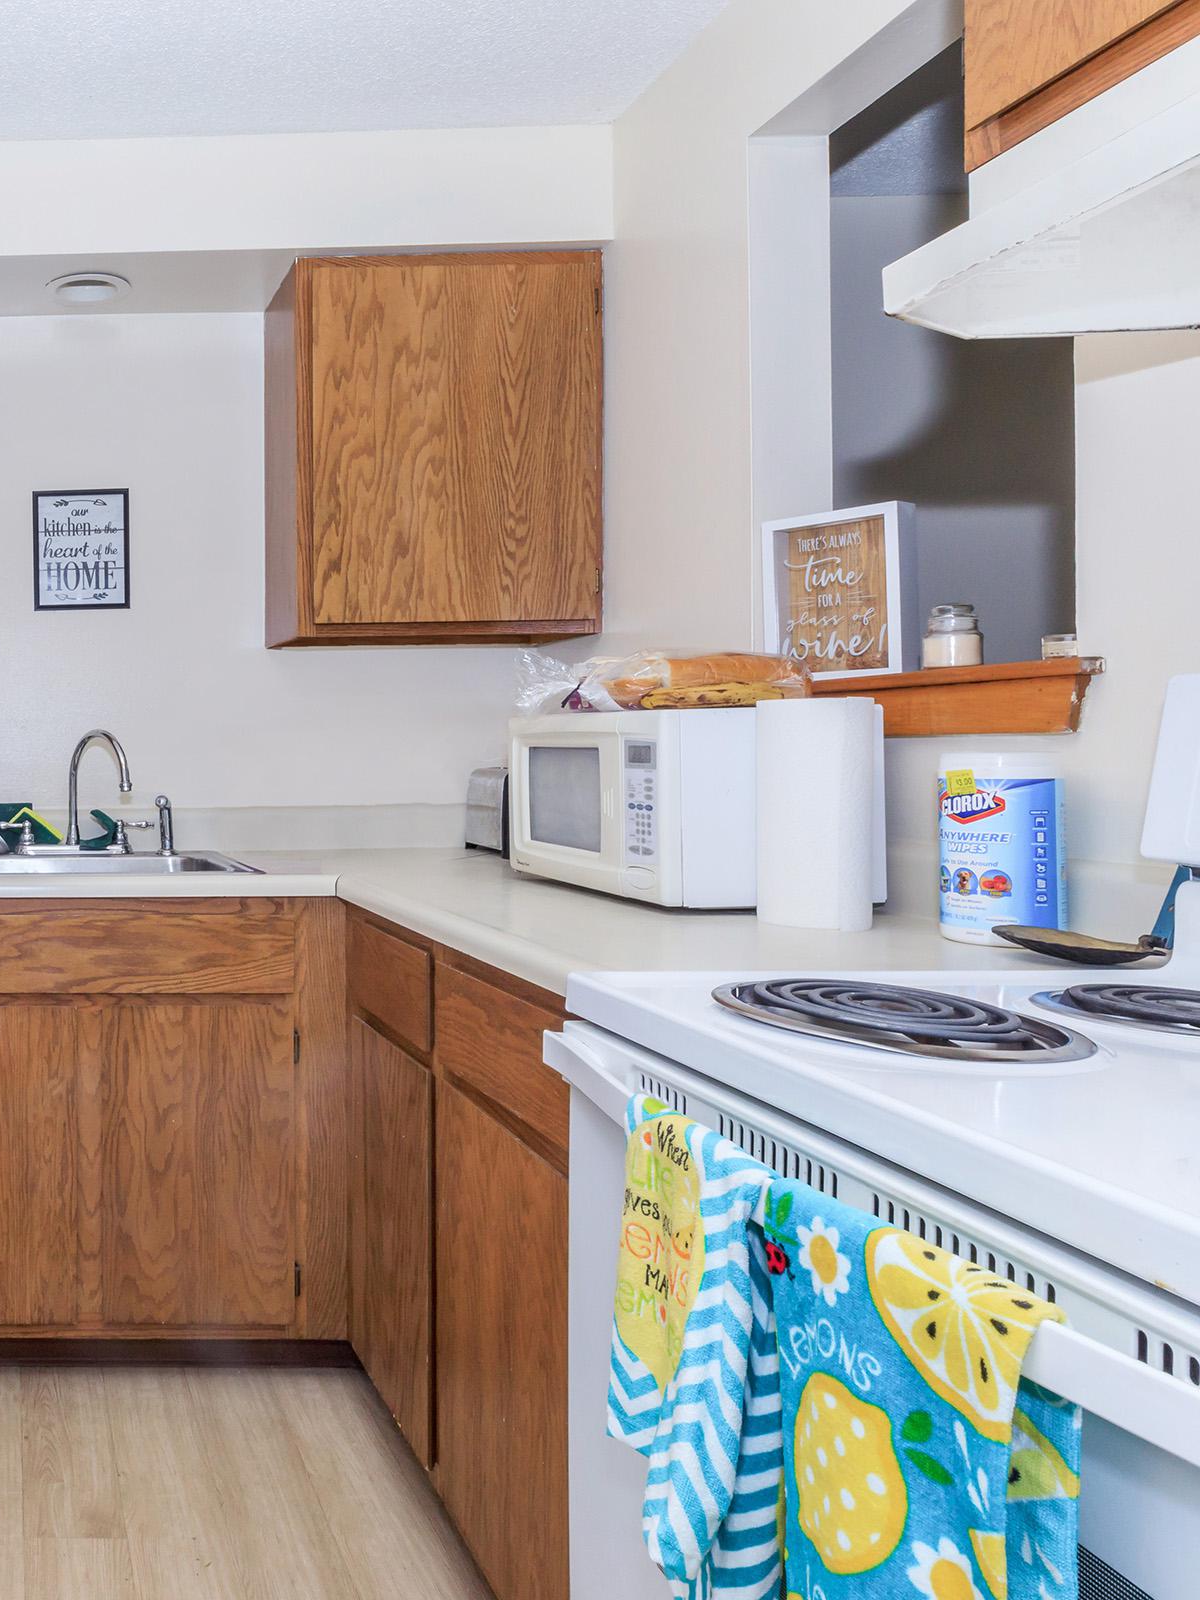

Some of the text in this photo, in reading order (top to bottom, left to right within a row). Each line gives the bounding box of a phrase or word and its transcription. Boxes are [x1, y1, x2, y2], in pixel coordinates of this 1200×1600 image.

[71, 508, 88, 516] our
[43, 517, 118, 537] kitchen is the
[43, 538, 118, 560] heart of the
[797, 530, 862, 552] THERE'S ALWAYS
[45, 560, 117, 591] HOME
[818, 594, 842, 607] FOR A
[786, 607, 877, 633] glass of
[941, 789, 998, 816] CLOROX
[947, 841, 988, 854] WIPES
[657, 1121, 689, 1171] When
